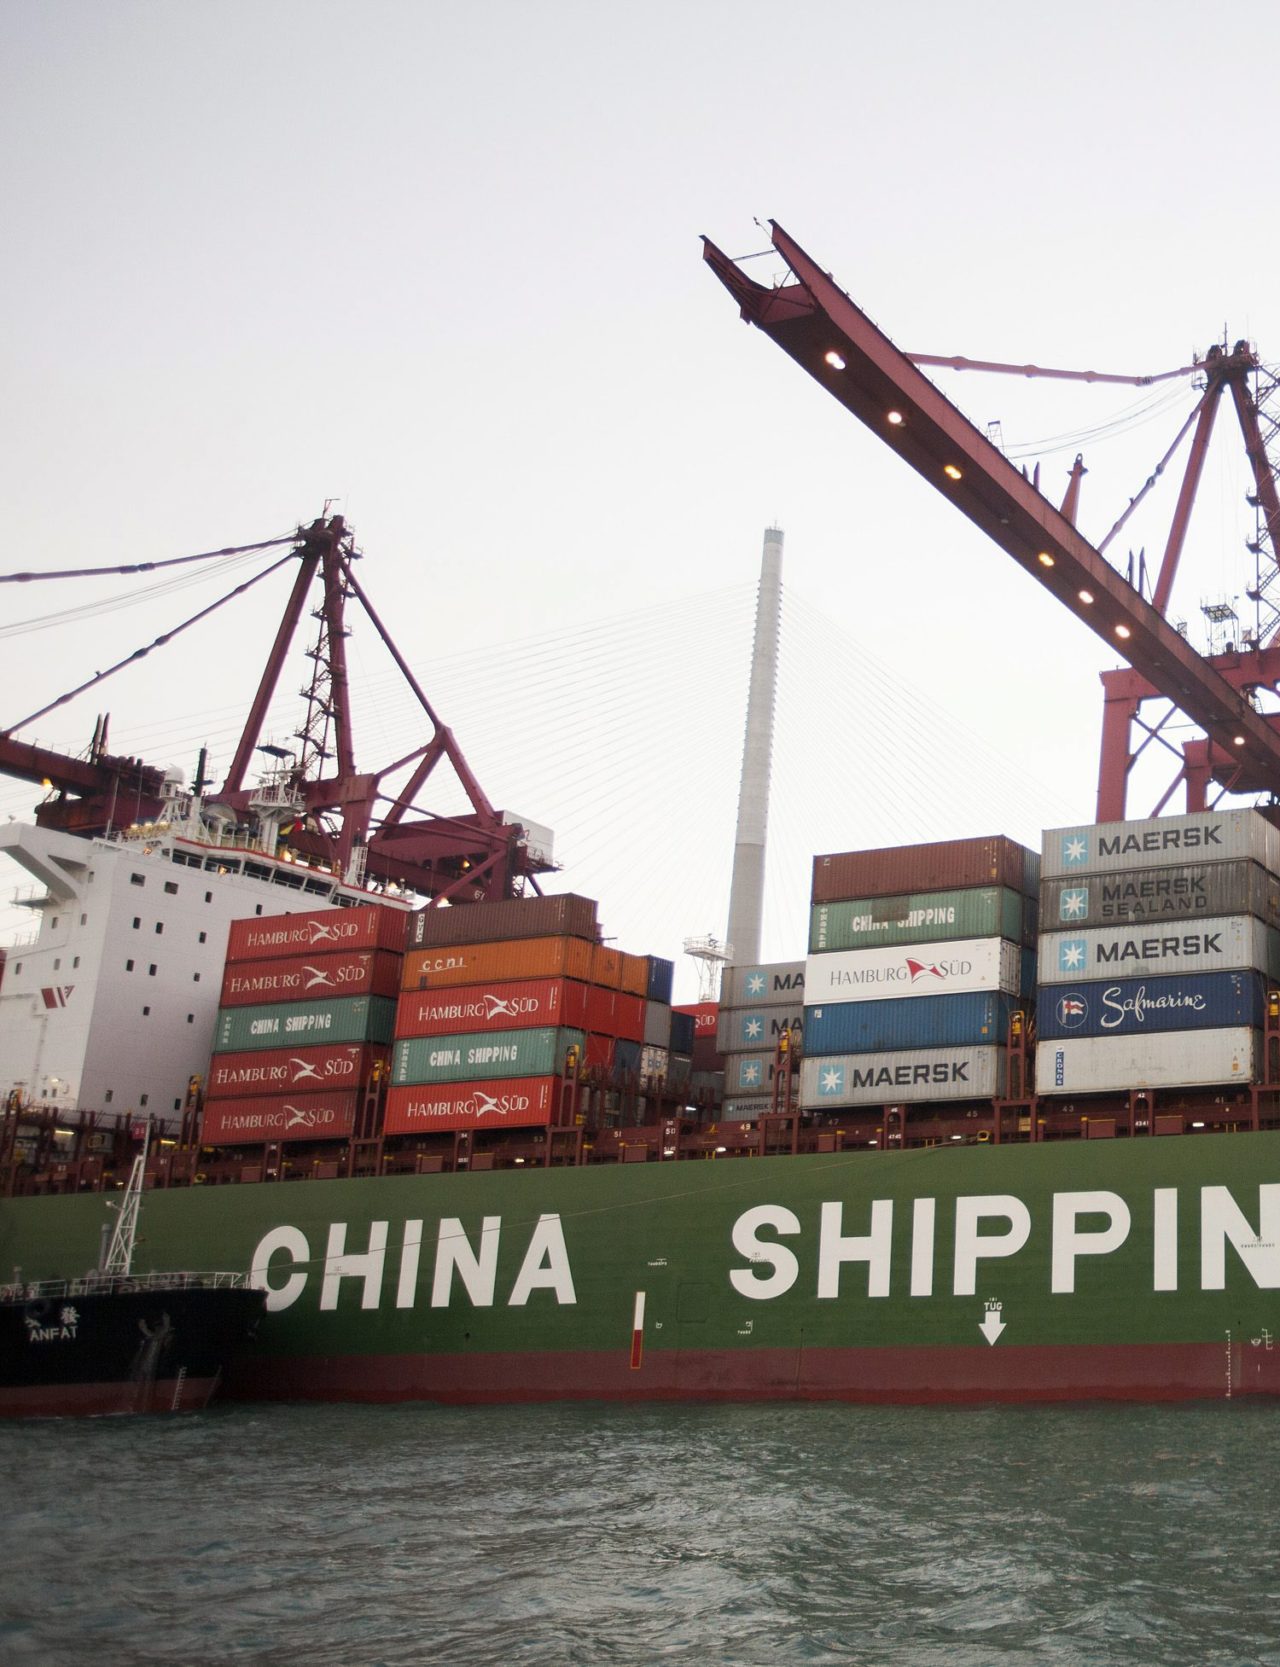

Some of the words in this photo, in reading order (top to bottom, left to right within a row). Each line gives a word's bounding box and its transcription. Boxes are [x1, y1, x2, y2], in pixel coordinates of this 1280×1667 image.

[1099, 825, 1223, 856] MAERSK
[1102, 876, 1207, 901] MAERSK
[1102, 895, 1208, 917] SEALAND
[247, 928, 309, 947] HAMBURG
[333, 922, 358, 938] SÜD
[1096, 933, 1223, 963] MAERSK
[230, 973, 300, 993] HAMBURG
[336, 965, 365, 983] SÜD
[830, 966, 907, 986] HAMBURG
[940, 960, 972, 976] SÜD
[419, 1003, 485, 1021] HAMBURG
[511, 997, 538, 1015] SÜD
[250, 1016, 279, 1035] CHINA
[285, 1014, 332, 1032] SHIPPING
[429, 1050, 461, 1067] CHINA
[468, 1045, 518, 1063] SHIPPING
[1056, 1052, 1064, 1085] CRONOS
[217, 1065, 288, 1084] HAMBURG
[324, 1058, 354, 1075] SÜD
[852, 1061, 970, 1088] MAERSK
[407, 1100, 475, 1118] HAMBURG
[501, 1094, 529, 1112] SÜD
[220, 1112, 284, 1130] HAMBURG
[309, 1108, 335, 1124] SÜD
[250, 1213, 577, 1312] CHINA
[984, 1302, 1003, 1311] TUG
[30, 1326, 78, 1342] ANFAT
